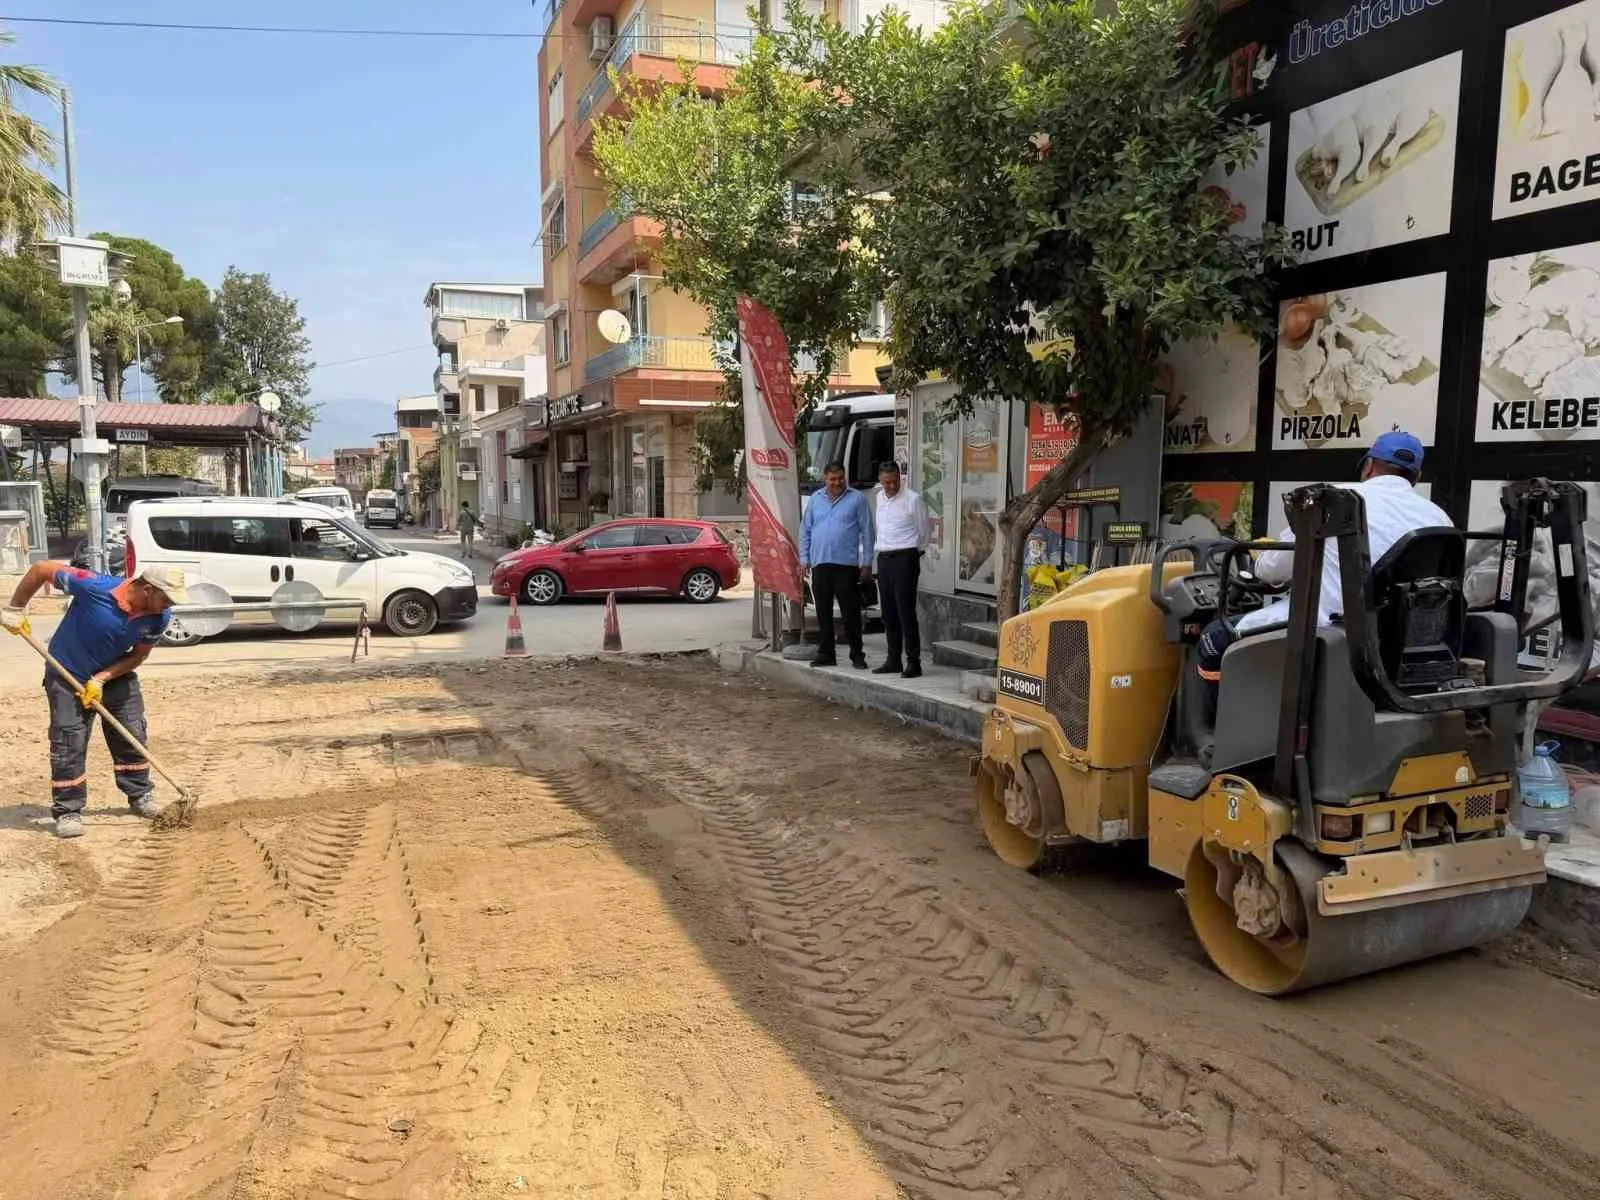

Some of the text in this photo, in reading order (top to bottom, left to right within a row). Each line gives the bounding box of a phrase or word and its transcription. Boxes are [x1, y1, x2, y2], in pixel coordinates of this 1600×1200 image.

[1511, 153, 1600, 202] BAGE
[1292, 221, 1340, 252] BUT
[1281, 411, 1361, 440] PİRZOLA
[1492, 396, 1600, 431] KELEBE
[119, 431, 146, 440] AYDIN
[1002, 675, 1040, 696] 15-89001
